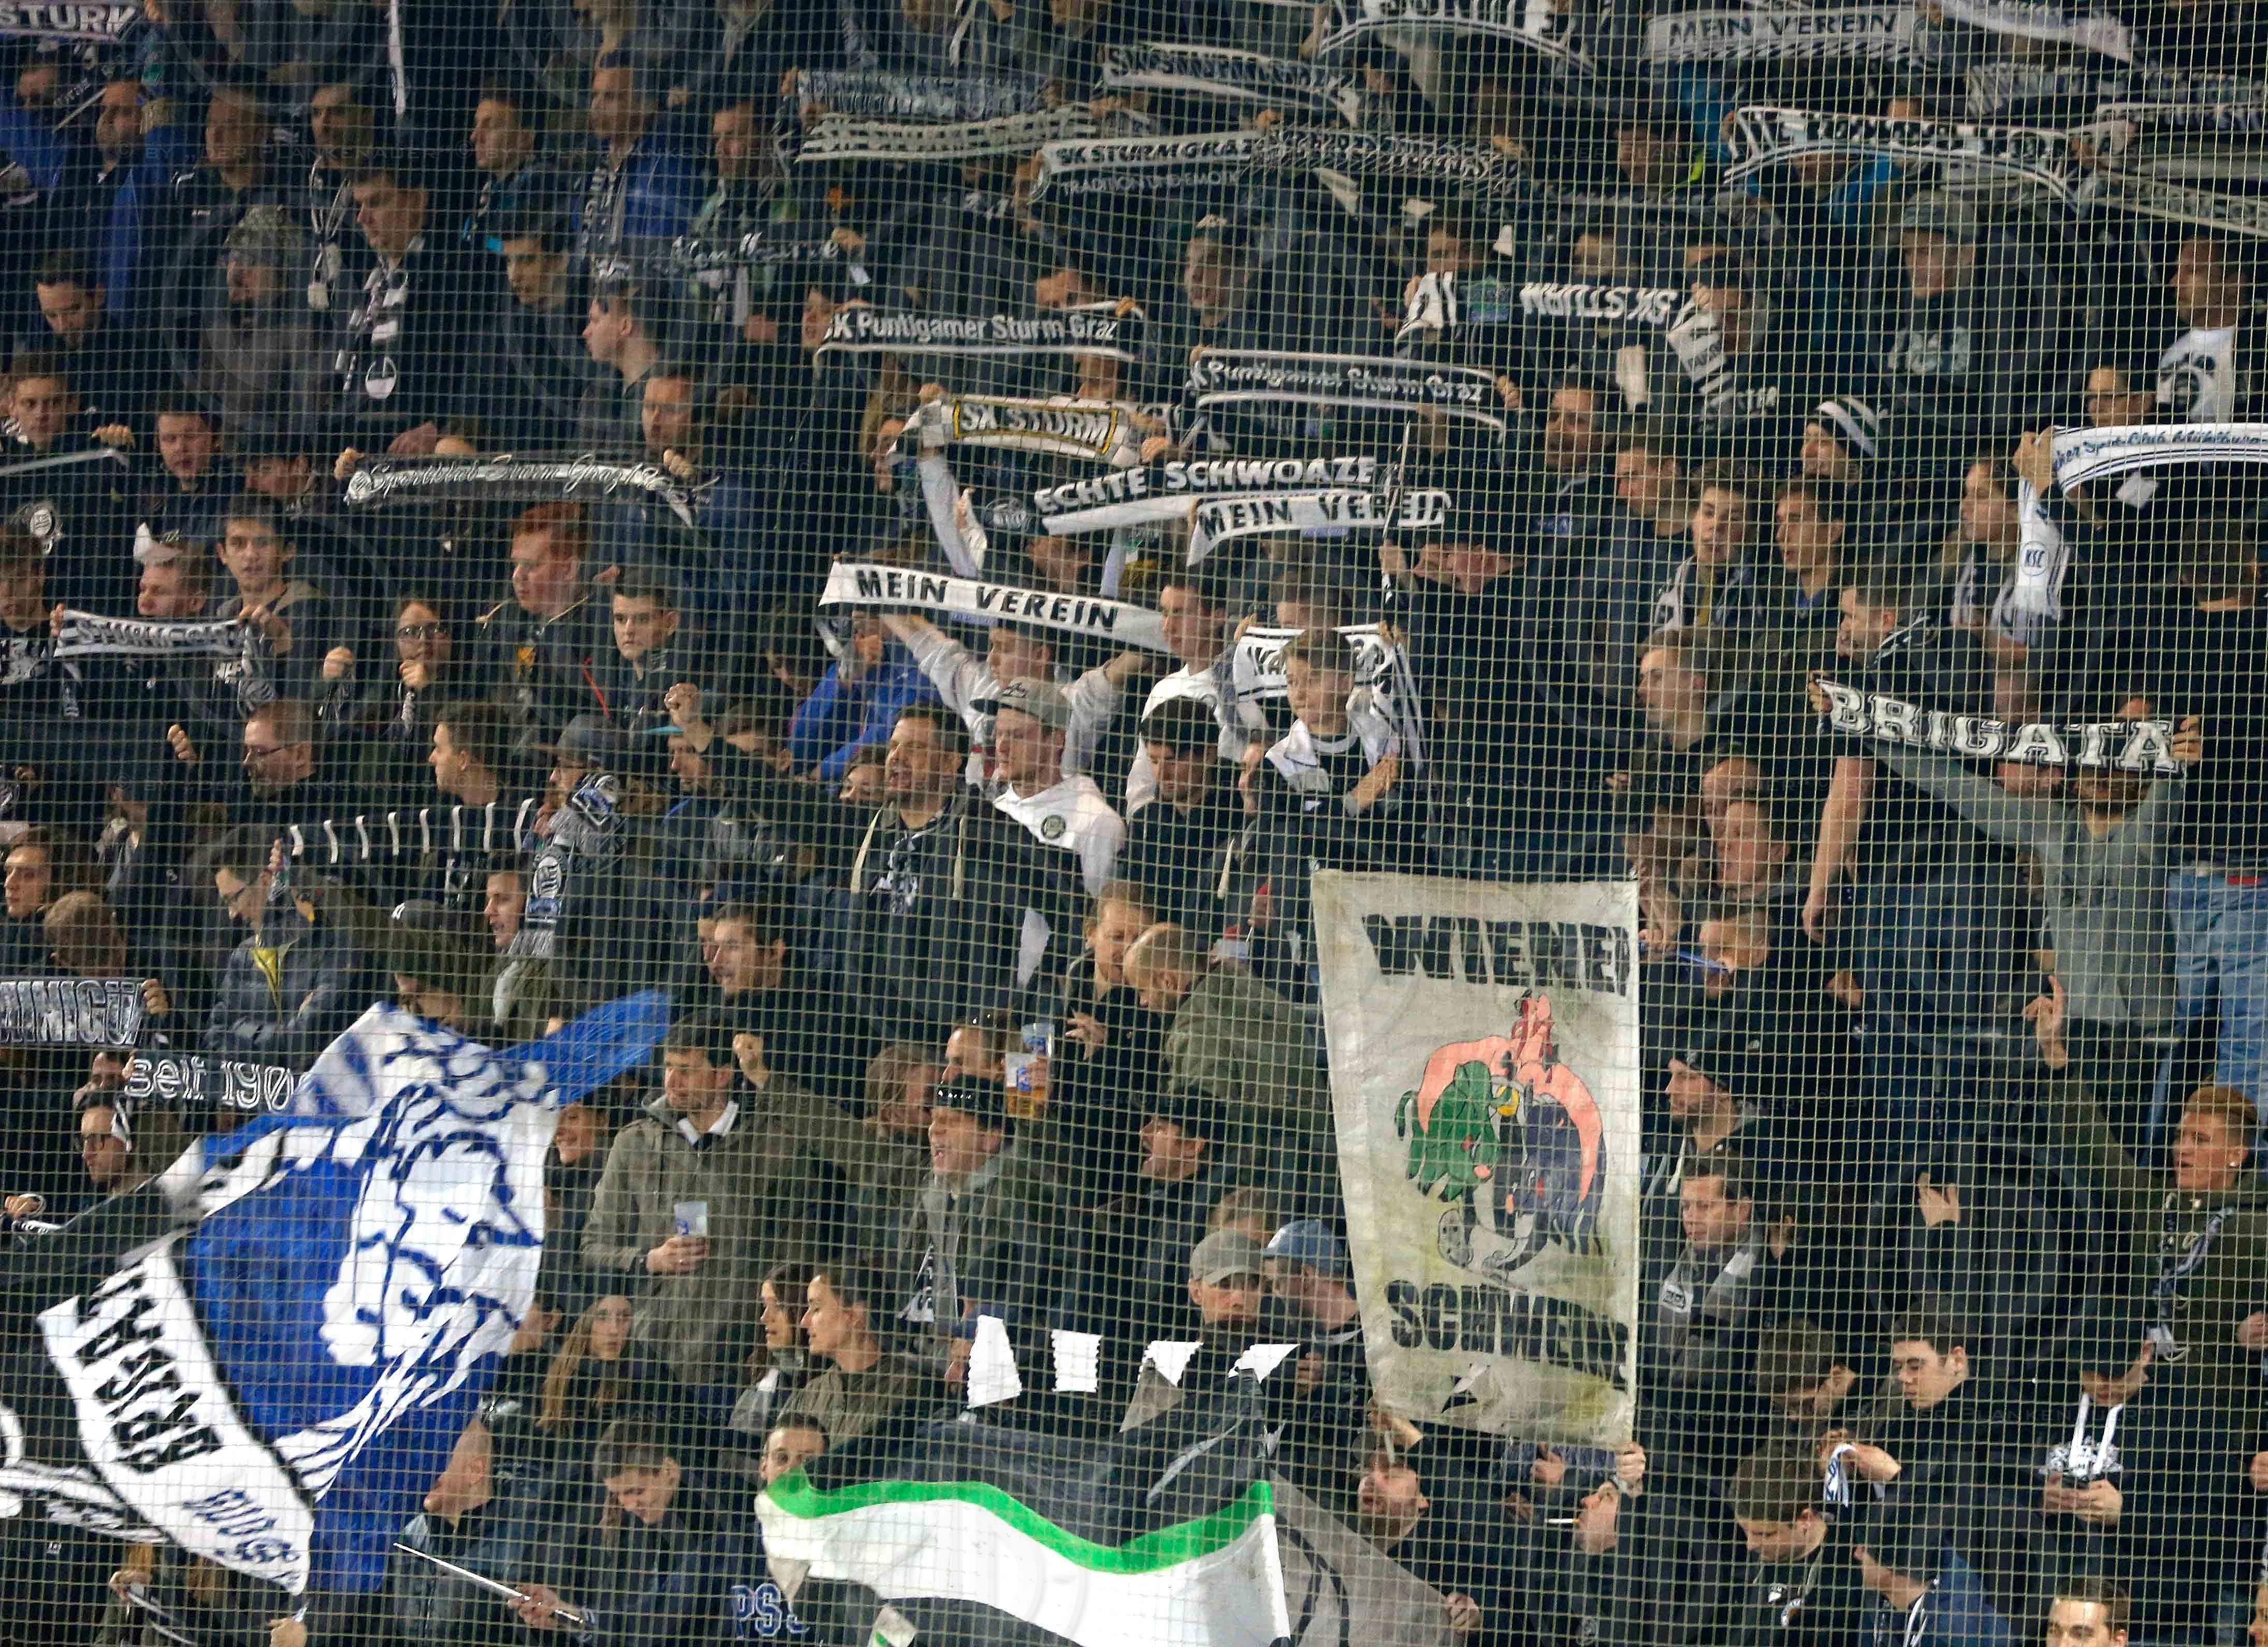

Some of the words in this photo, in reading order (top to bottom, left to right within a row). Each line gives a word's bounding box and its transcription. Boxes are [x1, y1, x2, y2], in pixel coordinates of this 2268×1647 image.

[856, 312, 986, 342] Puntigamer
[991, 313, 1065, 342] Sturm
[1034, 466, 1148, 514] ECHTE
[1166, 455, 1375, 489] SCHWOAZE
[1196, 499, 1292, 541] MEIN
[855, 568, 949, 604] MEIN
[975, 585, 1119, 634] VEREIN
[1815, 678, 2178, 773] BRIGATA
